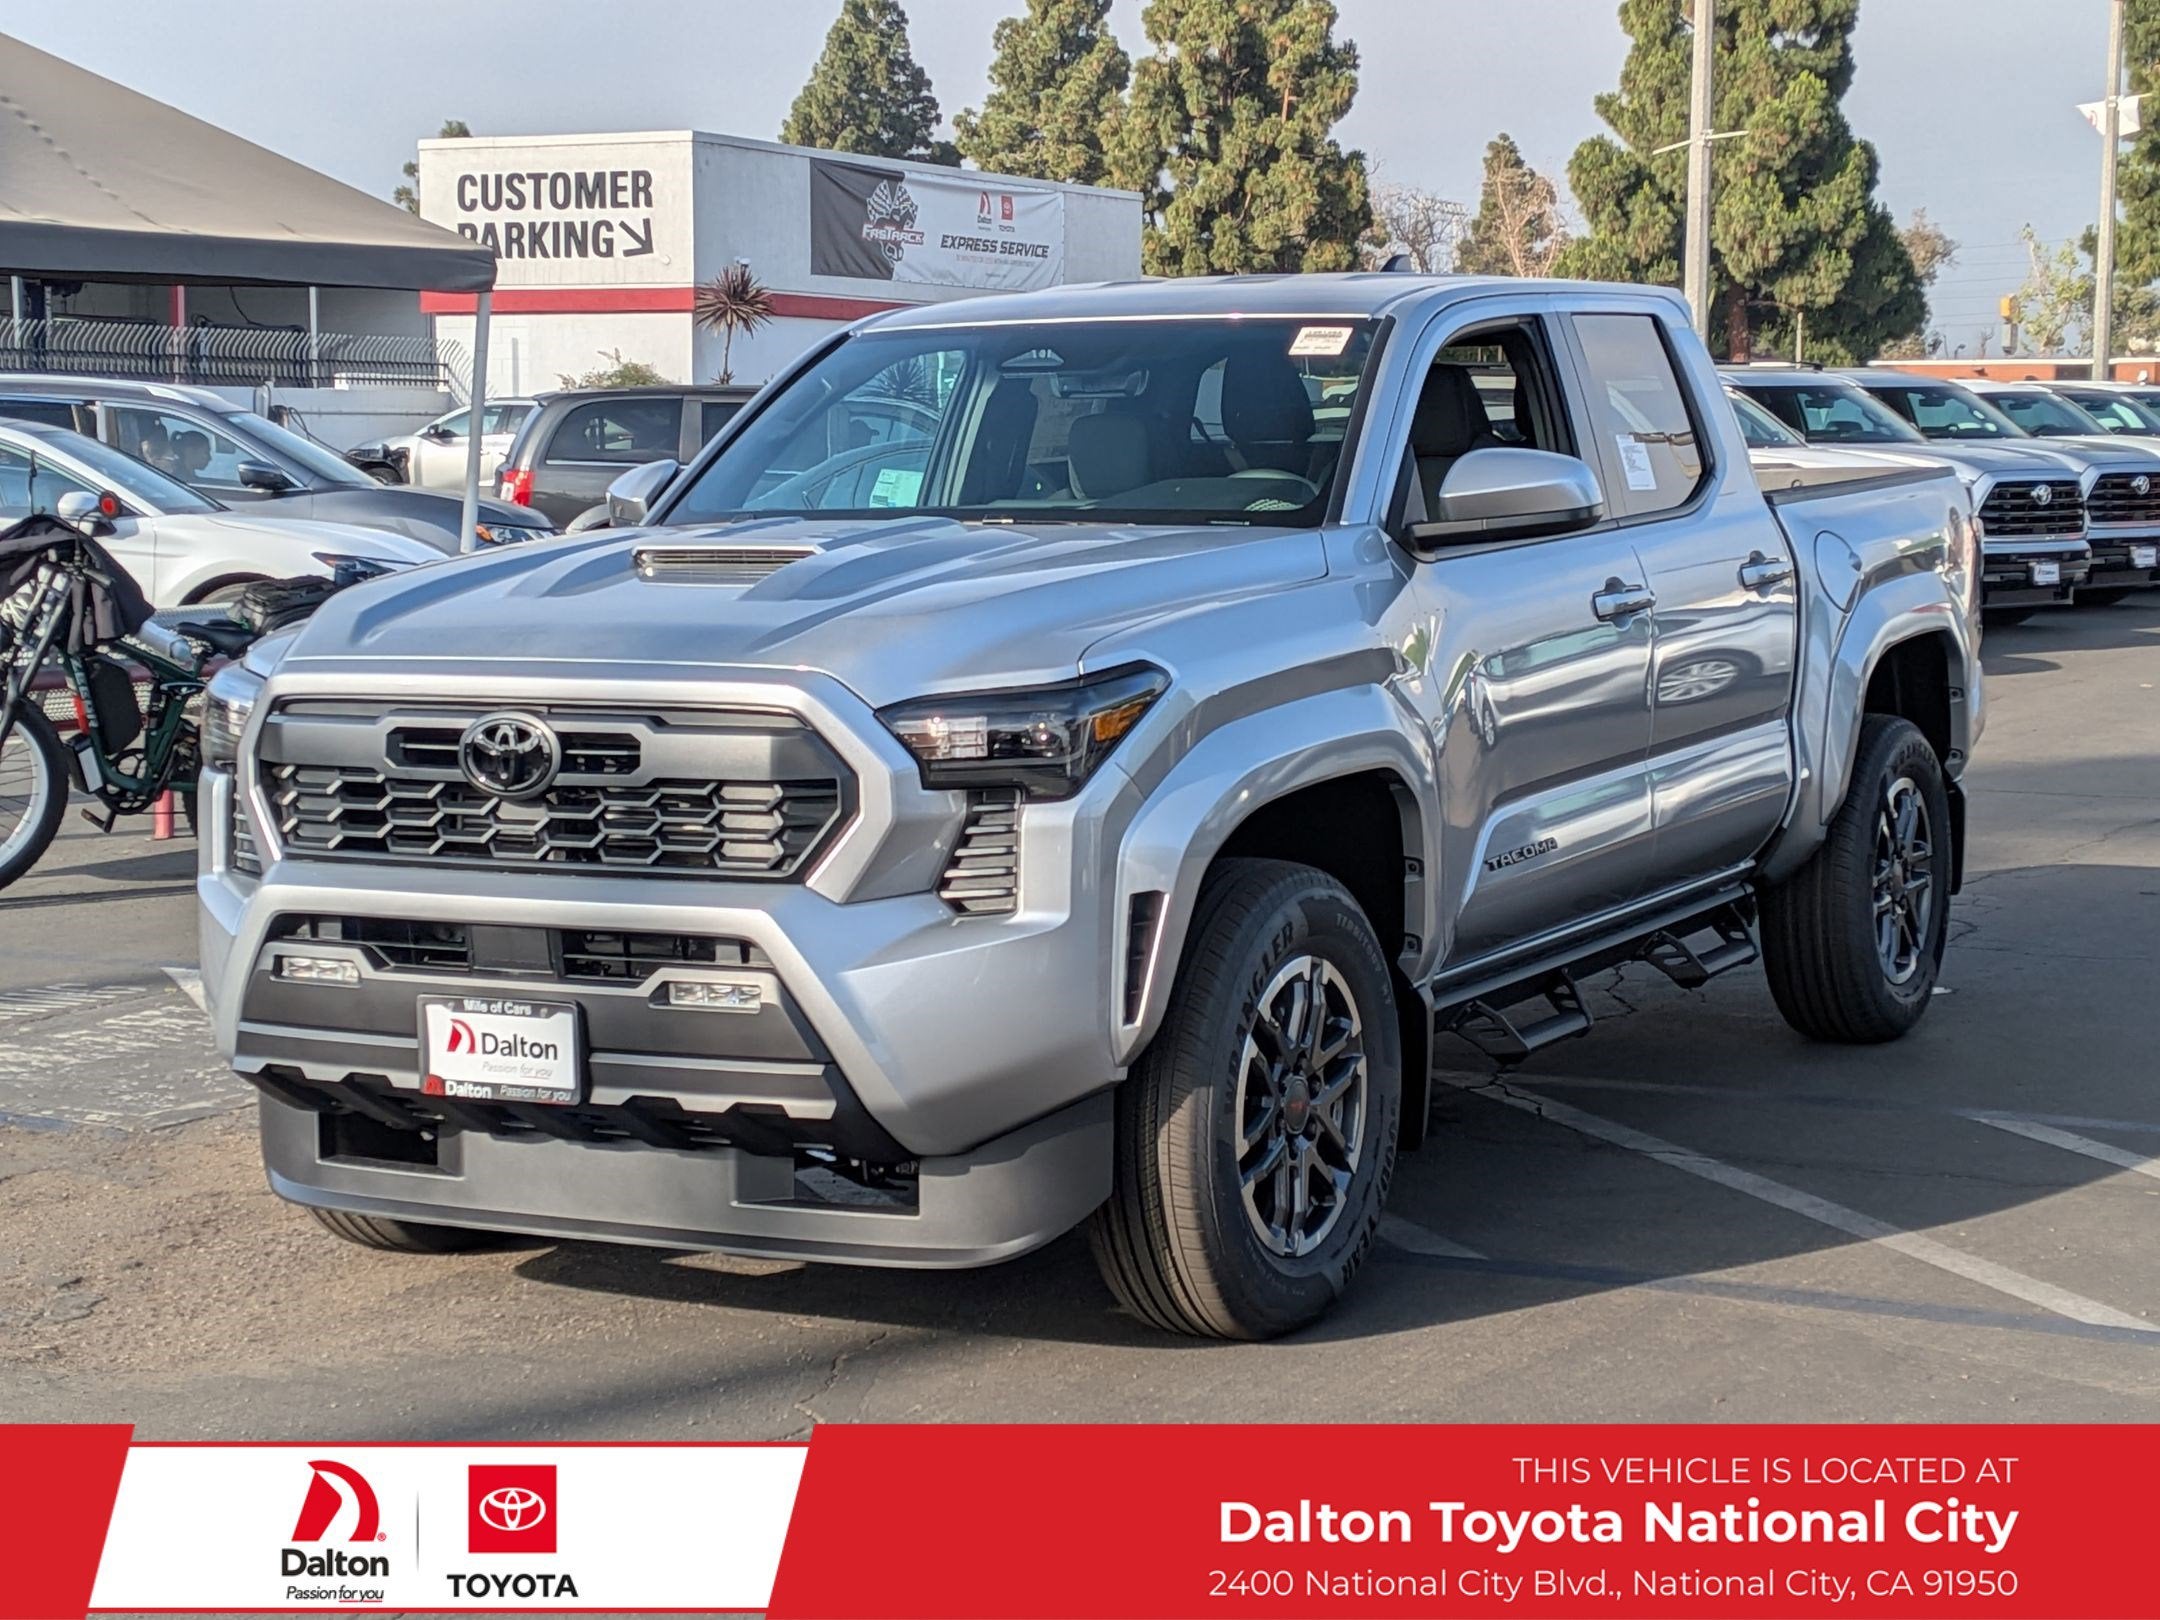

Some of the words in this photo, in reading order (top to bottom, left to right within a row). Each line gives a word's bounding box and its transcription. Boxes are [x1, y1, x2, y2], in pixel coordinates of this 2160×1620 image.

[457, 170, 653, 212] CUSTOMER
[940, 234, 998, 253] EXPRESS
[999, 241, 1049, 258] SERVICE
[1484, 837, 1558, 872] TACOMA
[463, 999, 488, 1013] Mile
[490, 1001, 502, 1014] of
[504, 1002, 532, 1016] Cars
[481, 1032, 558, 1061] Dalton
[445, 1081, 492, 1099] Dalton
[552, 1091, 572, 1102] you
